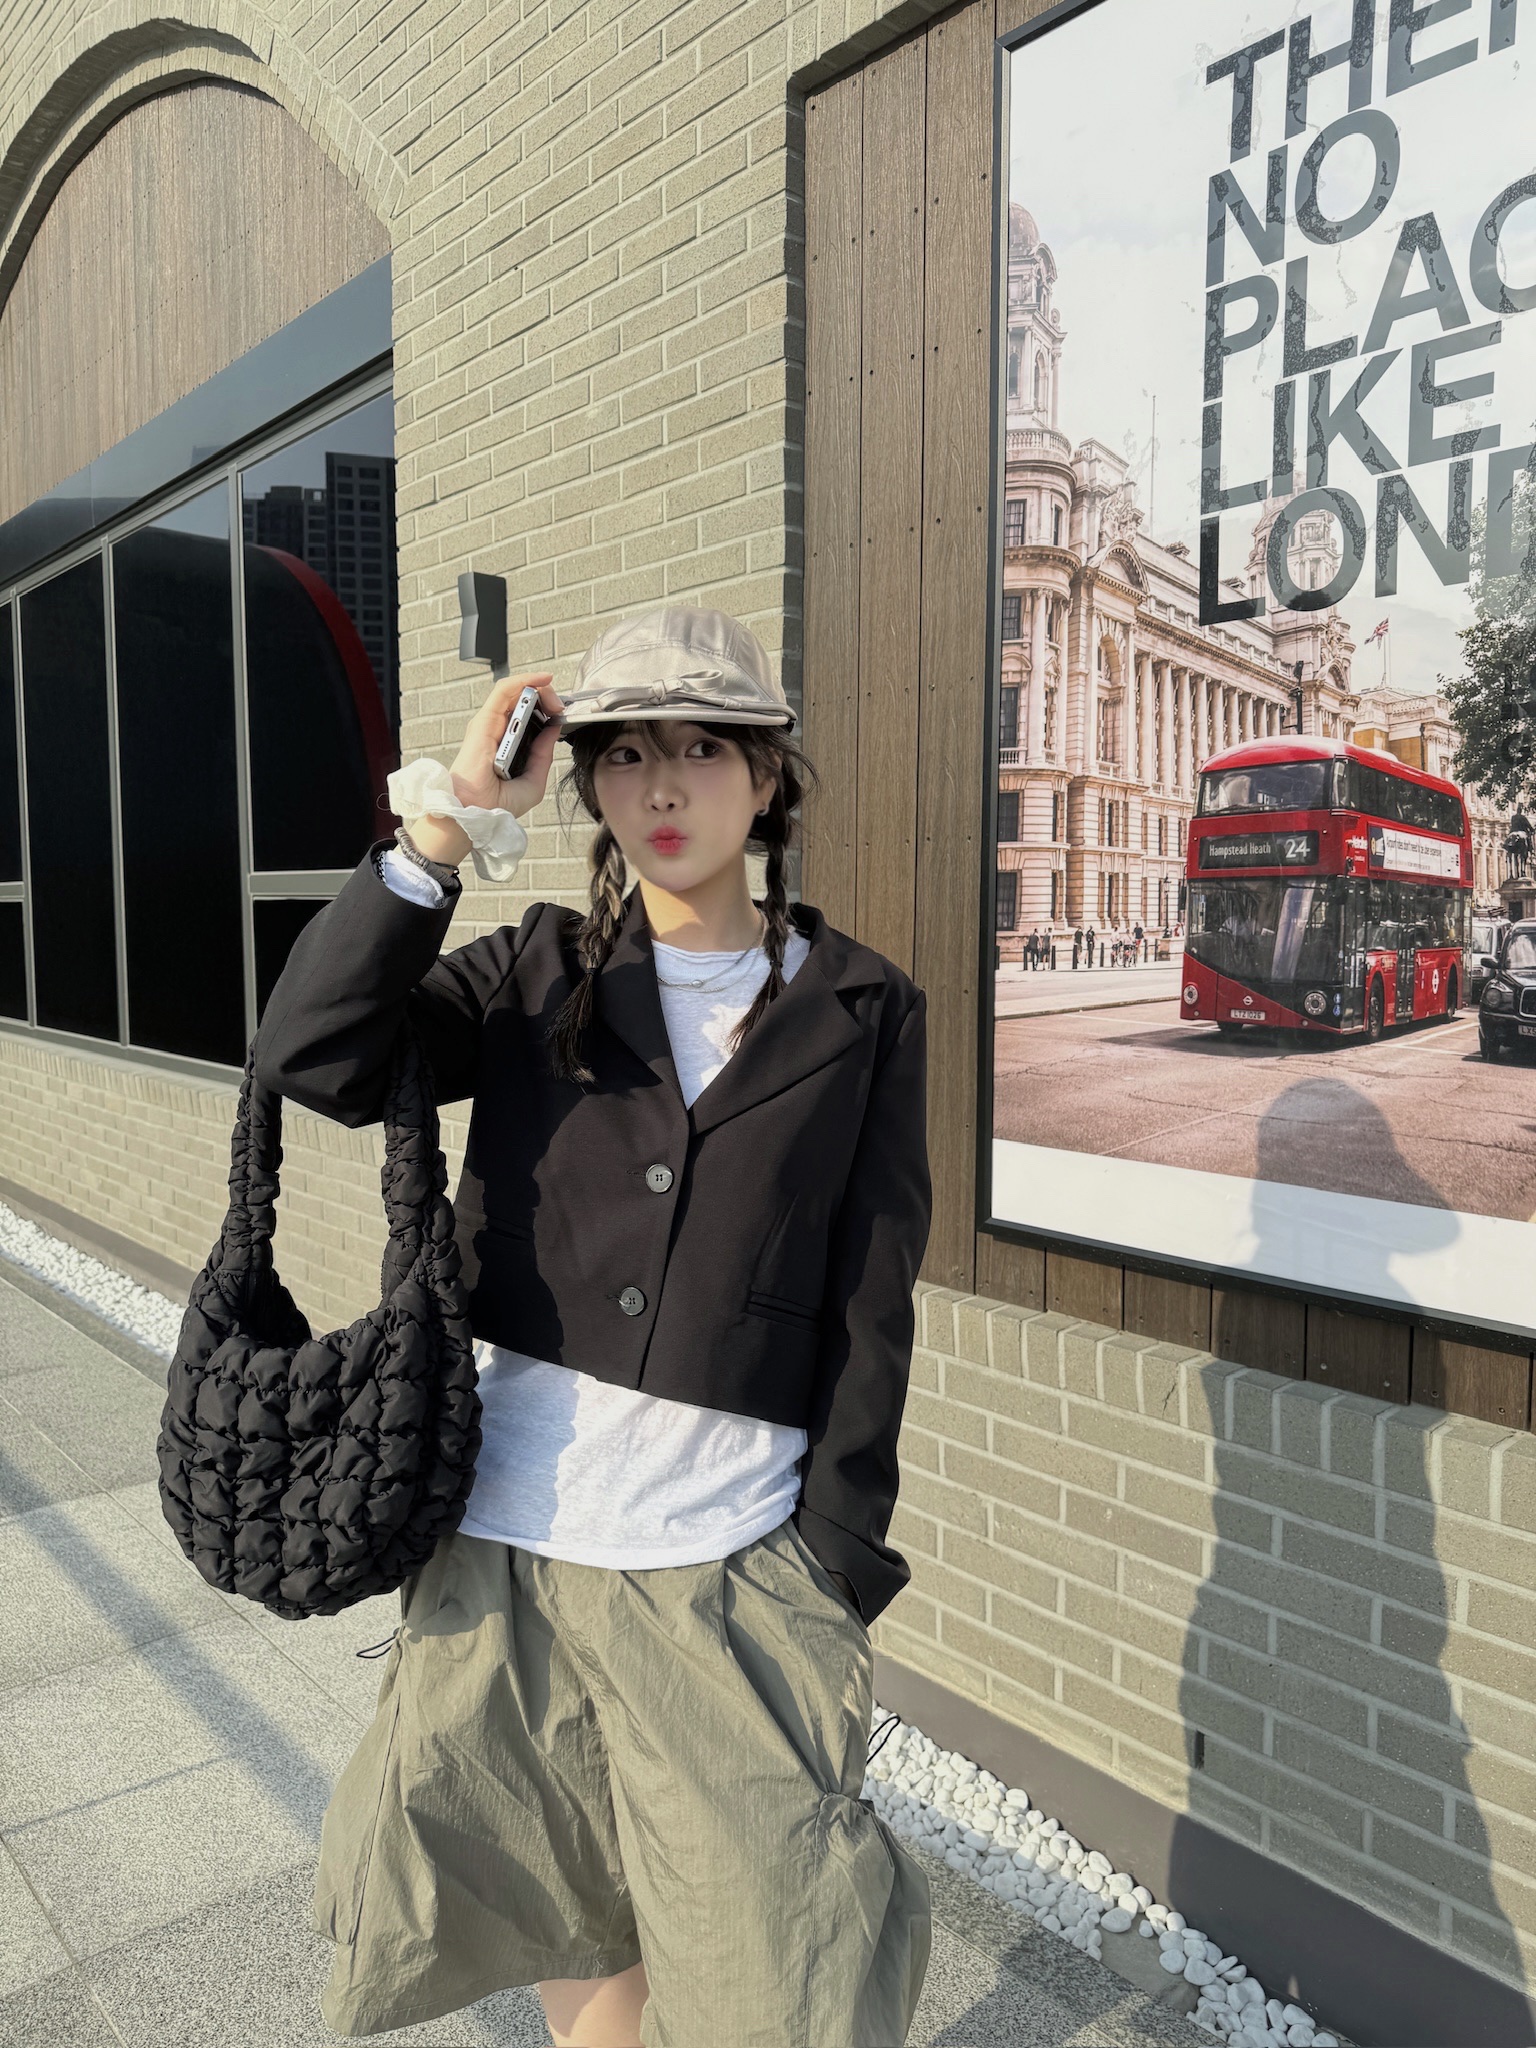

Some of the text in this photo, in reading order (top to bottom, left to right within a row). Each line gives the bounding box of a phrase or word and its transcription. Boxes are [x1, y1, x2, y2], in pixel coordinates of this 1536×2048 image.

[1206, 0, 1517, 164] THE
[1206, 109, 1400, 288] NO
[1200, 321, 1501, 516] LIKE
[1209, 836, 1311, 859] Hampstead Heath 24
